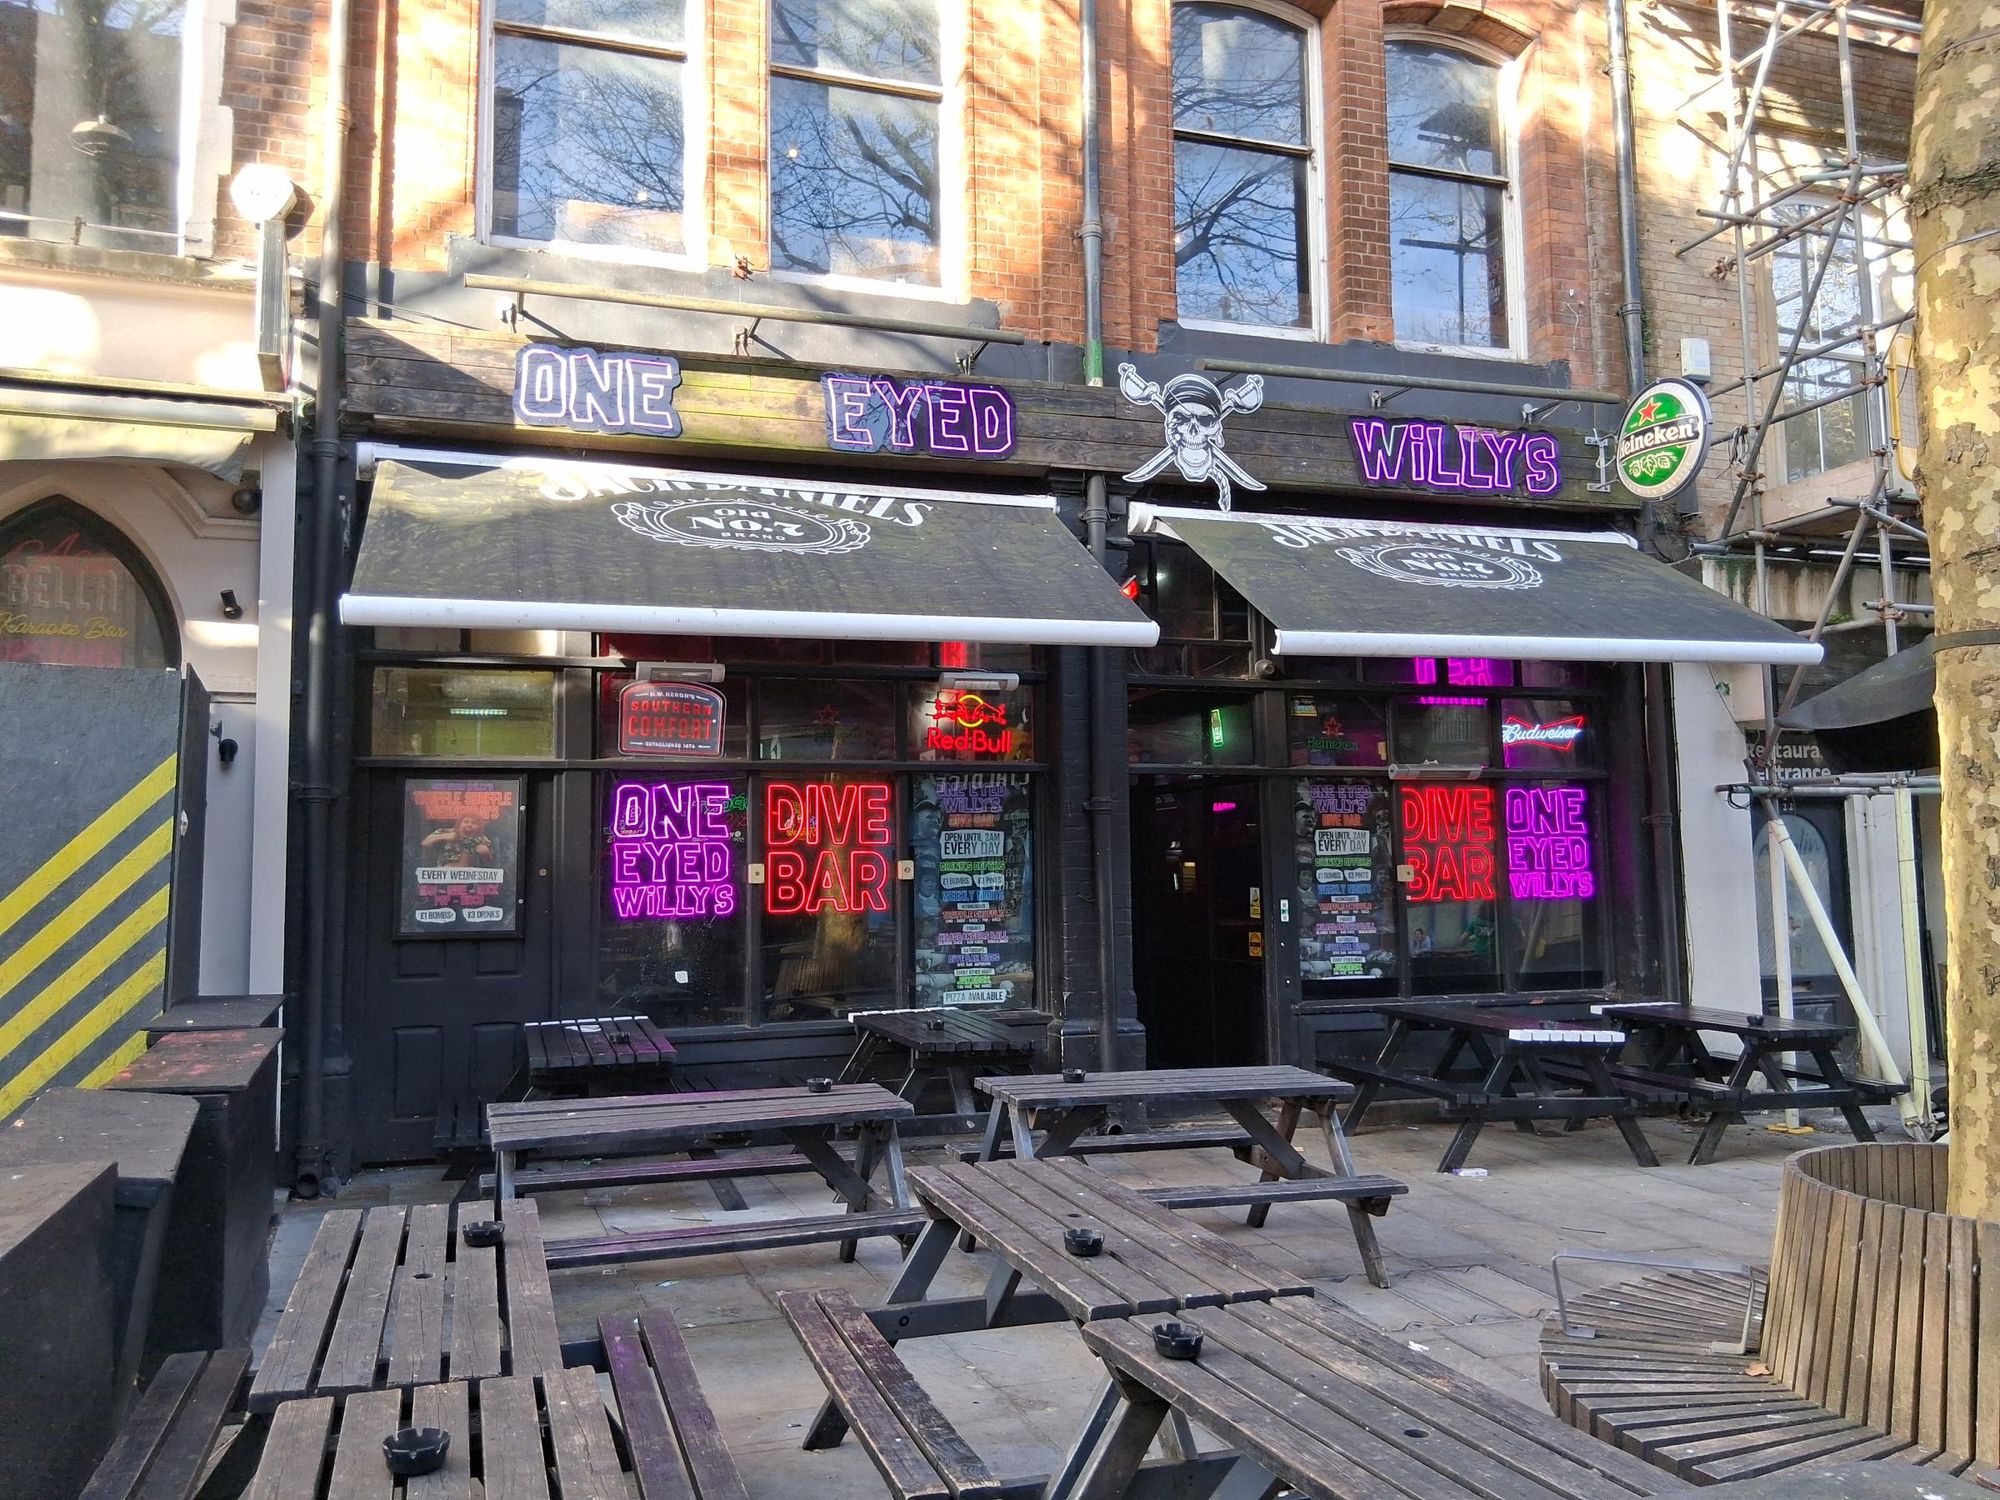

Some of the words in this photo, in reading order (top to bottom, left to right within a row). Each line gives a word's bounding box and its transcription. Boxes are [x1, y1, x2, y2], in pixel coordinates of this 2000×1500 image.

[518, 347, 674, 430] ONE
[825, 377, 1014, 454] EYED
[720, 532, 786, 541] BRAND
[1438, 572, 1489, 580] BRAND
[0, 611, 80, 637] Karaoke
[84, 616, 129, 640] Bar
[631, 700, 713, 716] SOUTHERN
[628, 714, 713, 741] COMFORT
[1502, 723, 1582, 744] Budweiser
[927, 726, 969, 752] Red
[971, 728, 1012, 753] Bull
[969, 781, 1008, 797] EYED
[1311, 784, 1336, 799] ONE
[1338, 784, 1371, 799] EYED
[613, 783, 731, 839] ONE
[767, 783, 890, 845] DIVE
[1400, 787, 1495, 842] DIVE
[1506, 787, 1587, 835] ONE
[944, 832, 963, 841] OPEN
[963, 832, 983, 841] UNTIL
[984, 832, 1001, 841] 2AM
[1318, 831, 1334, 840] OPEN
[1334, 831, 1351, 840] UNTIL
[1352, 831, 1367, 840] 2AM
[944, 841, 978, 855] EVERY
[980, 841, 1001, 855] DAY
[1318, 839, 1348, 852] EVERY
[1349, 839, 1367, 852] DAY
[1506, 836, 1589, 871] EYED
[613, 842, 730, 883] EYED
[940, 861, 972, 872] DRINKS
[421, 869, 450, 881] EVERY
[450, 869, 499, 882] WEDNESDAY
[1402, 845, 1495, 900] BAR
[767, 850, 888, 914] BAR
[950, 877, 970, 885] BOMBS
[420, 911, 428, 920] £1
[428, 911, 452, 920] BOMBS
[467, 910, 476, 919] £3
[476, 910, 500, 919] DRINKS
[945, 992, 966, 1002] PIZZA
[967, 990, 1004, 1002] AVAILABLE
